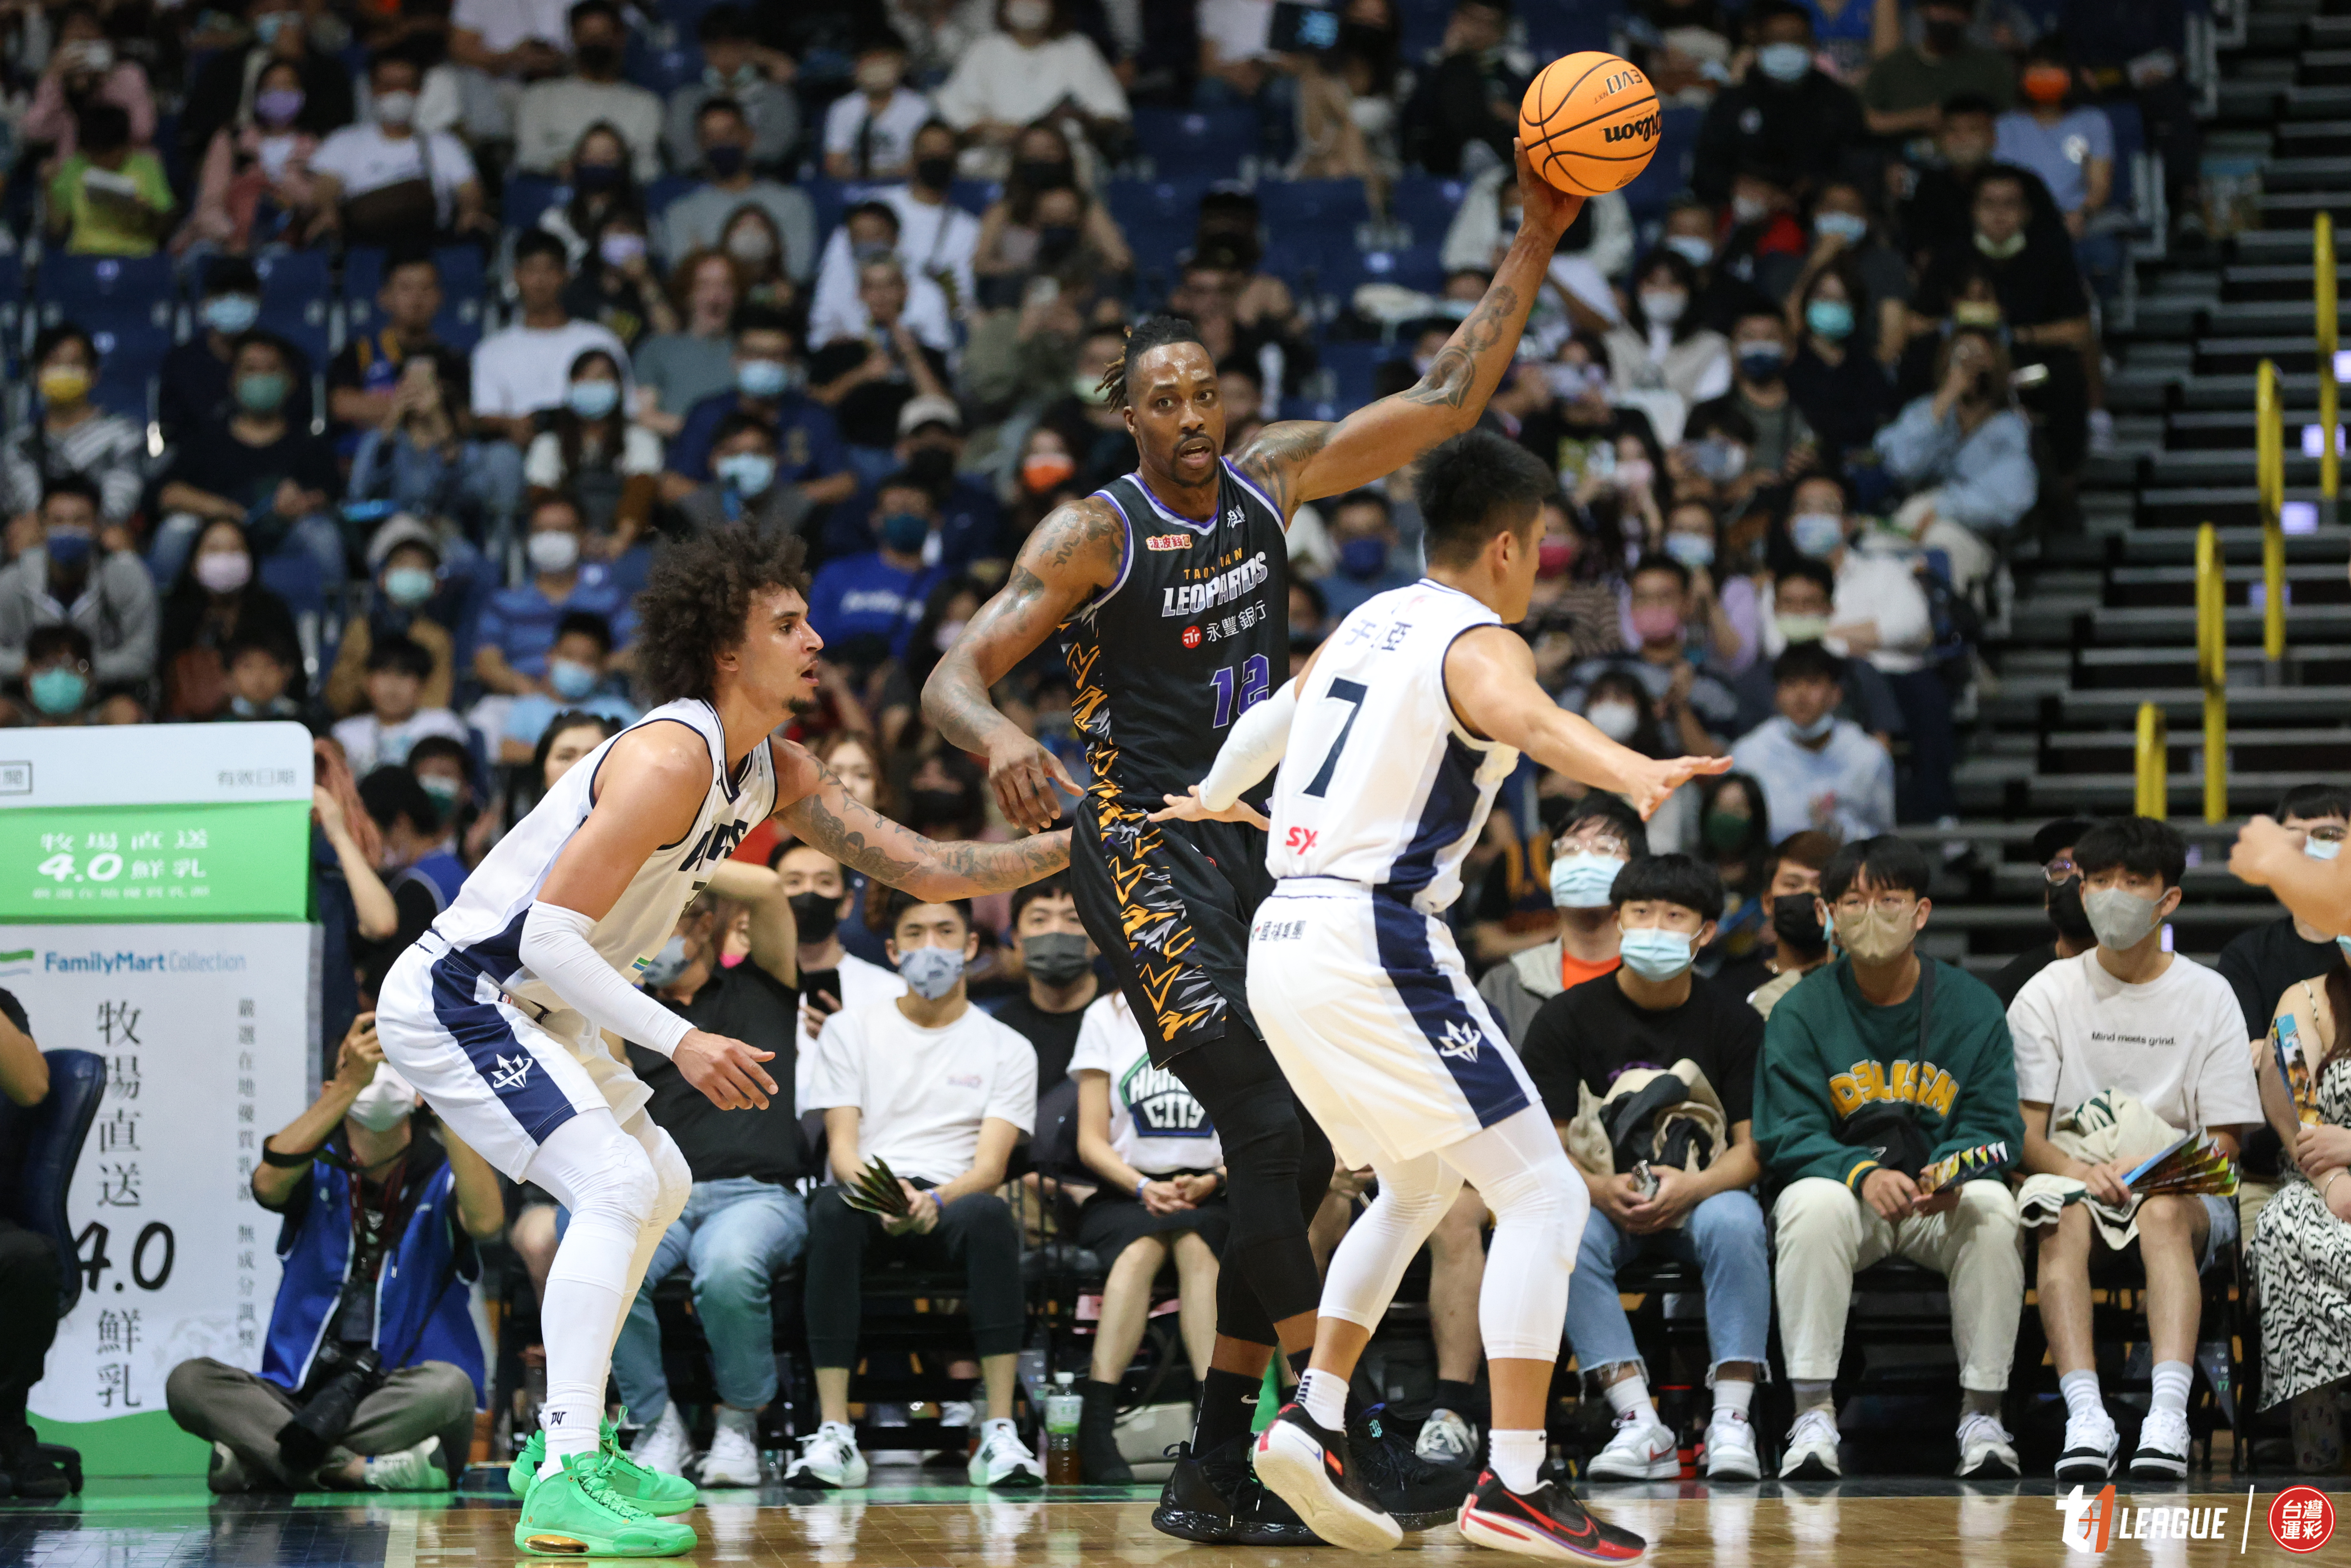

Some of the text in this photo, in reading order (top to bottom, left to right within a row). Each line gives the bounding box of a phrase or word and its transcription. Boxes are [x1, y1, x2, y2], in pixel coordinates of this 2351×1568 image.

[1161, 551, 1268, 617] LEOPARDS
[1206, 599, 1266, 642] 永豐銀行
[1344, 618, 1413, 651] 于亞
[1209, 653, 1269, 729] 12
[1302, 677, 1369, 798] 7
[1285, 826, 1318, 856] SY
[37, 852, 207, 883] 4.0 鮮乳
[45, 950, 247, 975] FamilyMart Collection
[2092, 1031, 2116, 1041] Mind
[2118, 1034, 2147, 1044] meets
[1142, 1092, 1206, 1128] CITY
[75, 1221, 175, 1292] 4.0
[96, 1307, 142, 1408] 鮮乳
